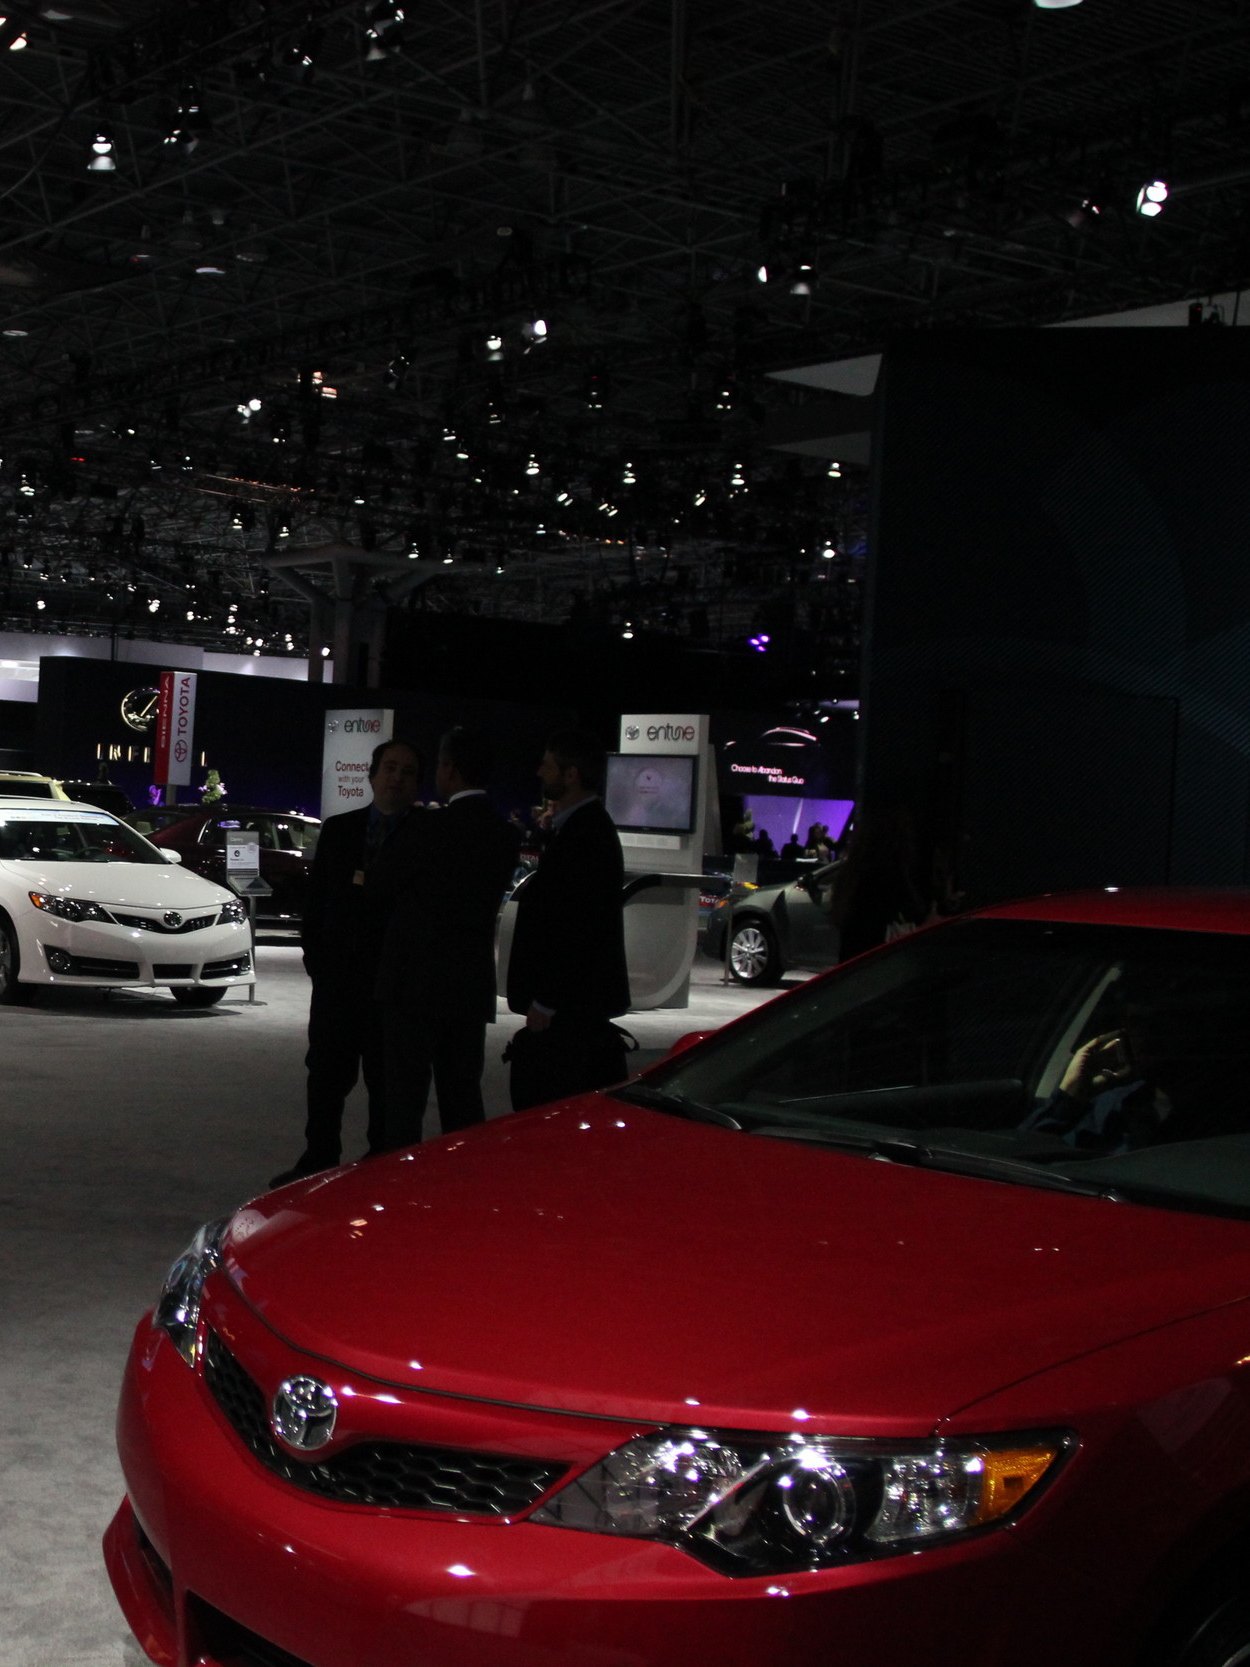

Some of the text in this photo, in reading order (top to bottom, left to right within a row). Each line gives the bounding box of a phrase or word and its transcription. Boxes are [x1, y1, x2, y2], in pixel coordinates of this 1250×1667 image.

[160, 675, 170, 749] SIENNA
[177, 677, 190, 736] TOYOTA
[344, 717, 381, 733] entune
[646, 722, 695, 741] entune
[335, 760, 370, 772] Connect
[337, 785, 364, 799] Toyota
